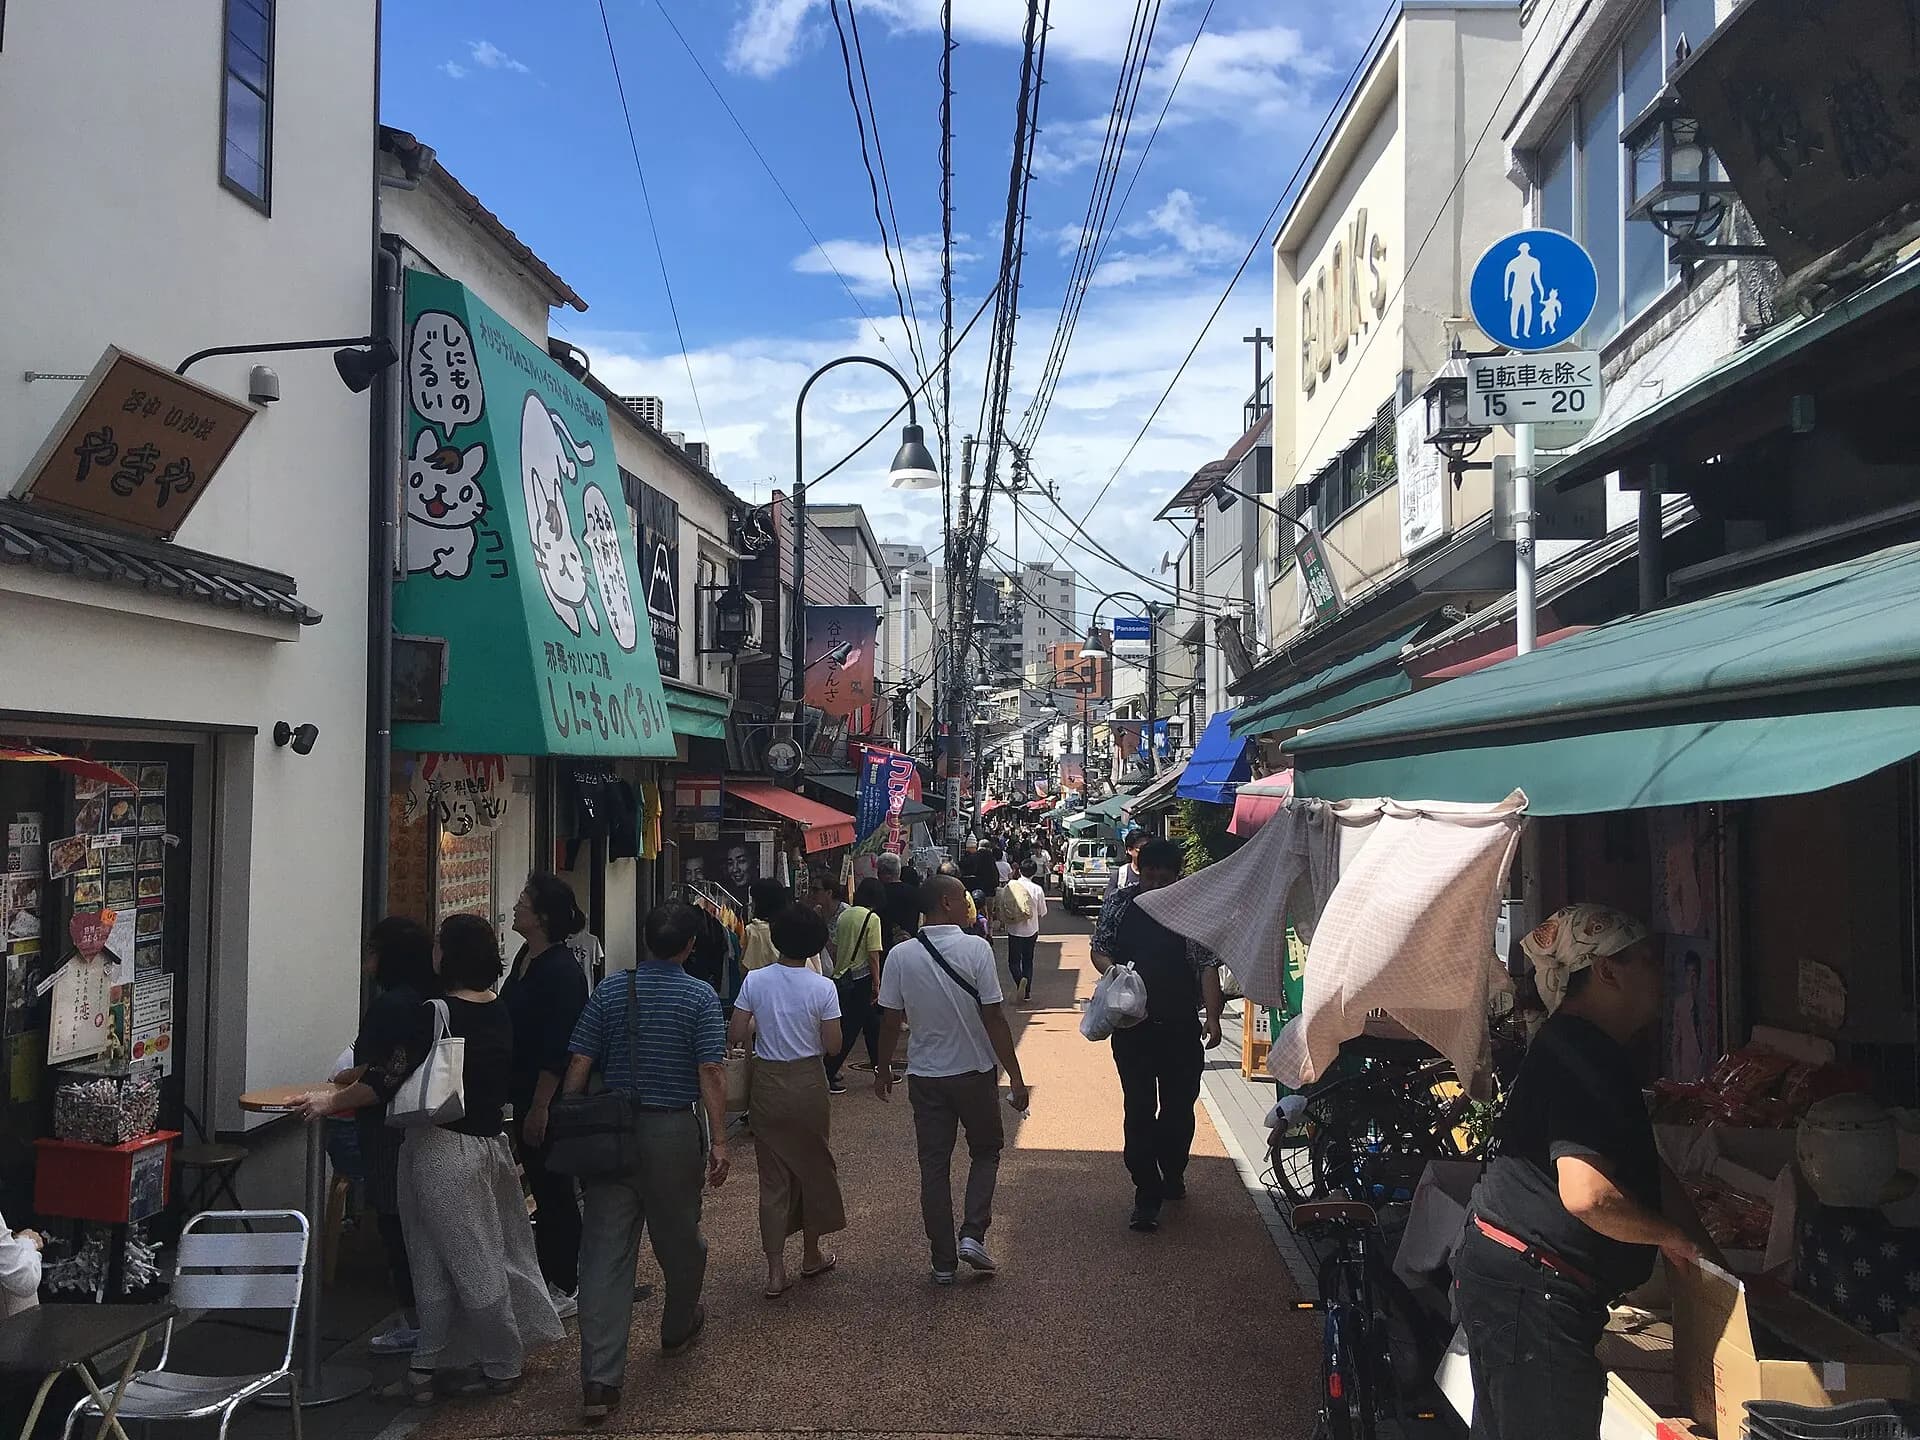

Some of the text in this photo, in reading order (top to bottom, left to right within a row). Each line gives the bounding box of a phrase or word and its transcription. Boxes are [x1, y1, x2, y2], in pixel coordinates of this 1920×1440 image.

[419, 330, 443, 410] ぐるい
[443, 324, 470, 414] しにもの
[1475, 361, 1592, 390] 自転車を除く
[1483, 392, 1508, 417] 15
[1551, 389, 1586, 413] 20
[75, 426, 195, 508] やきや
[547, 676, 666, 741] しにものぐるい
